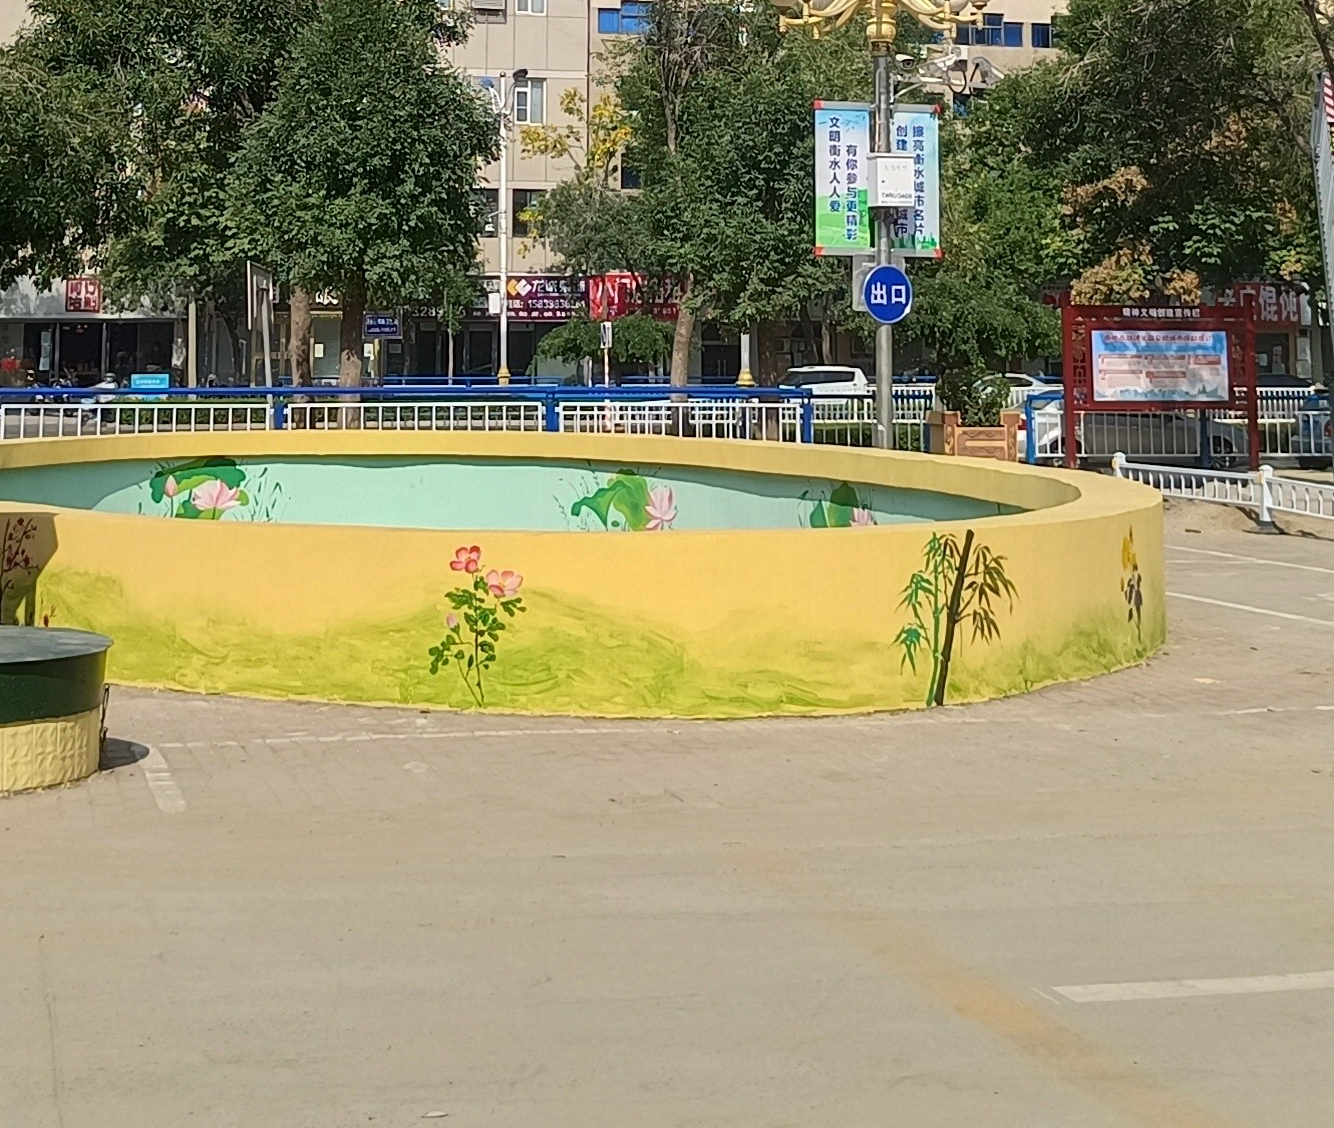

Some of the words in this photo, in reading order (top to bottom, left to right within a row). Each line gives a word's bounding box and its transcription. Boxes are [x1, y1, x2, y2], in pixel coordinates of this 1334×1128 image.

[829, 117, 841, 213] 文明衡水人人爱
[871, 282, 906, 305] 出口
